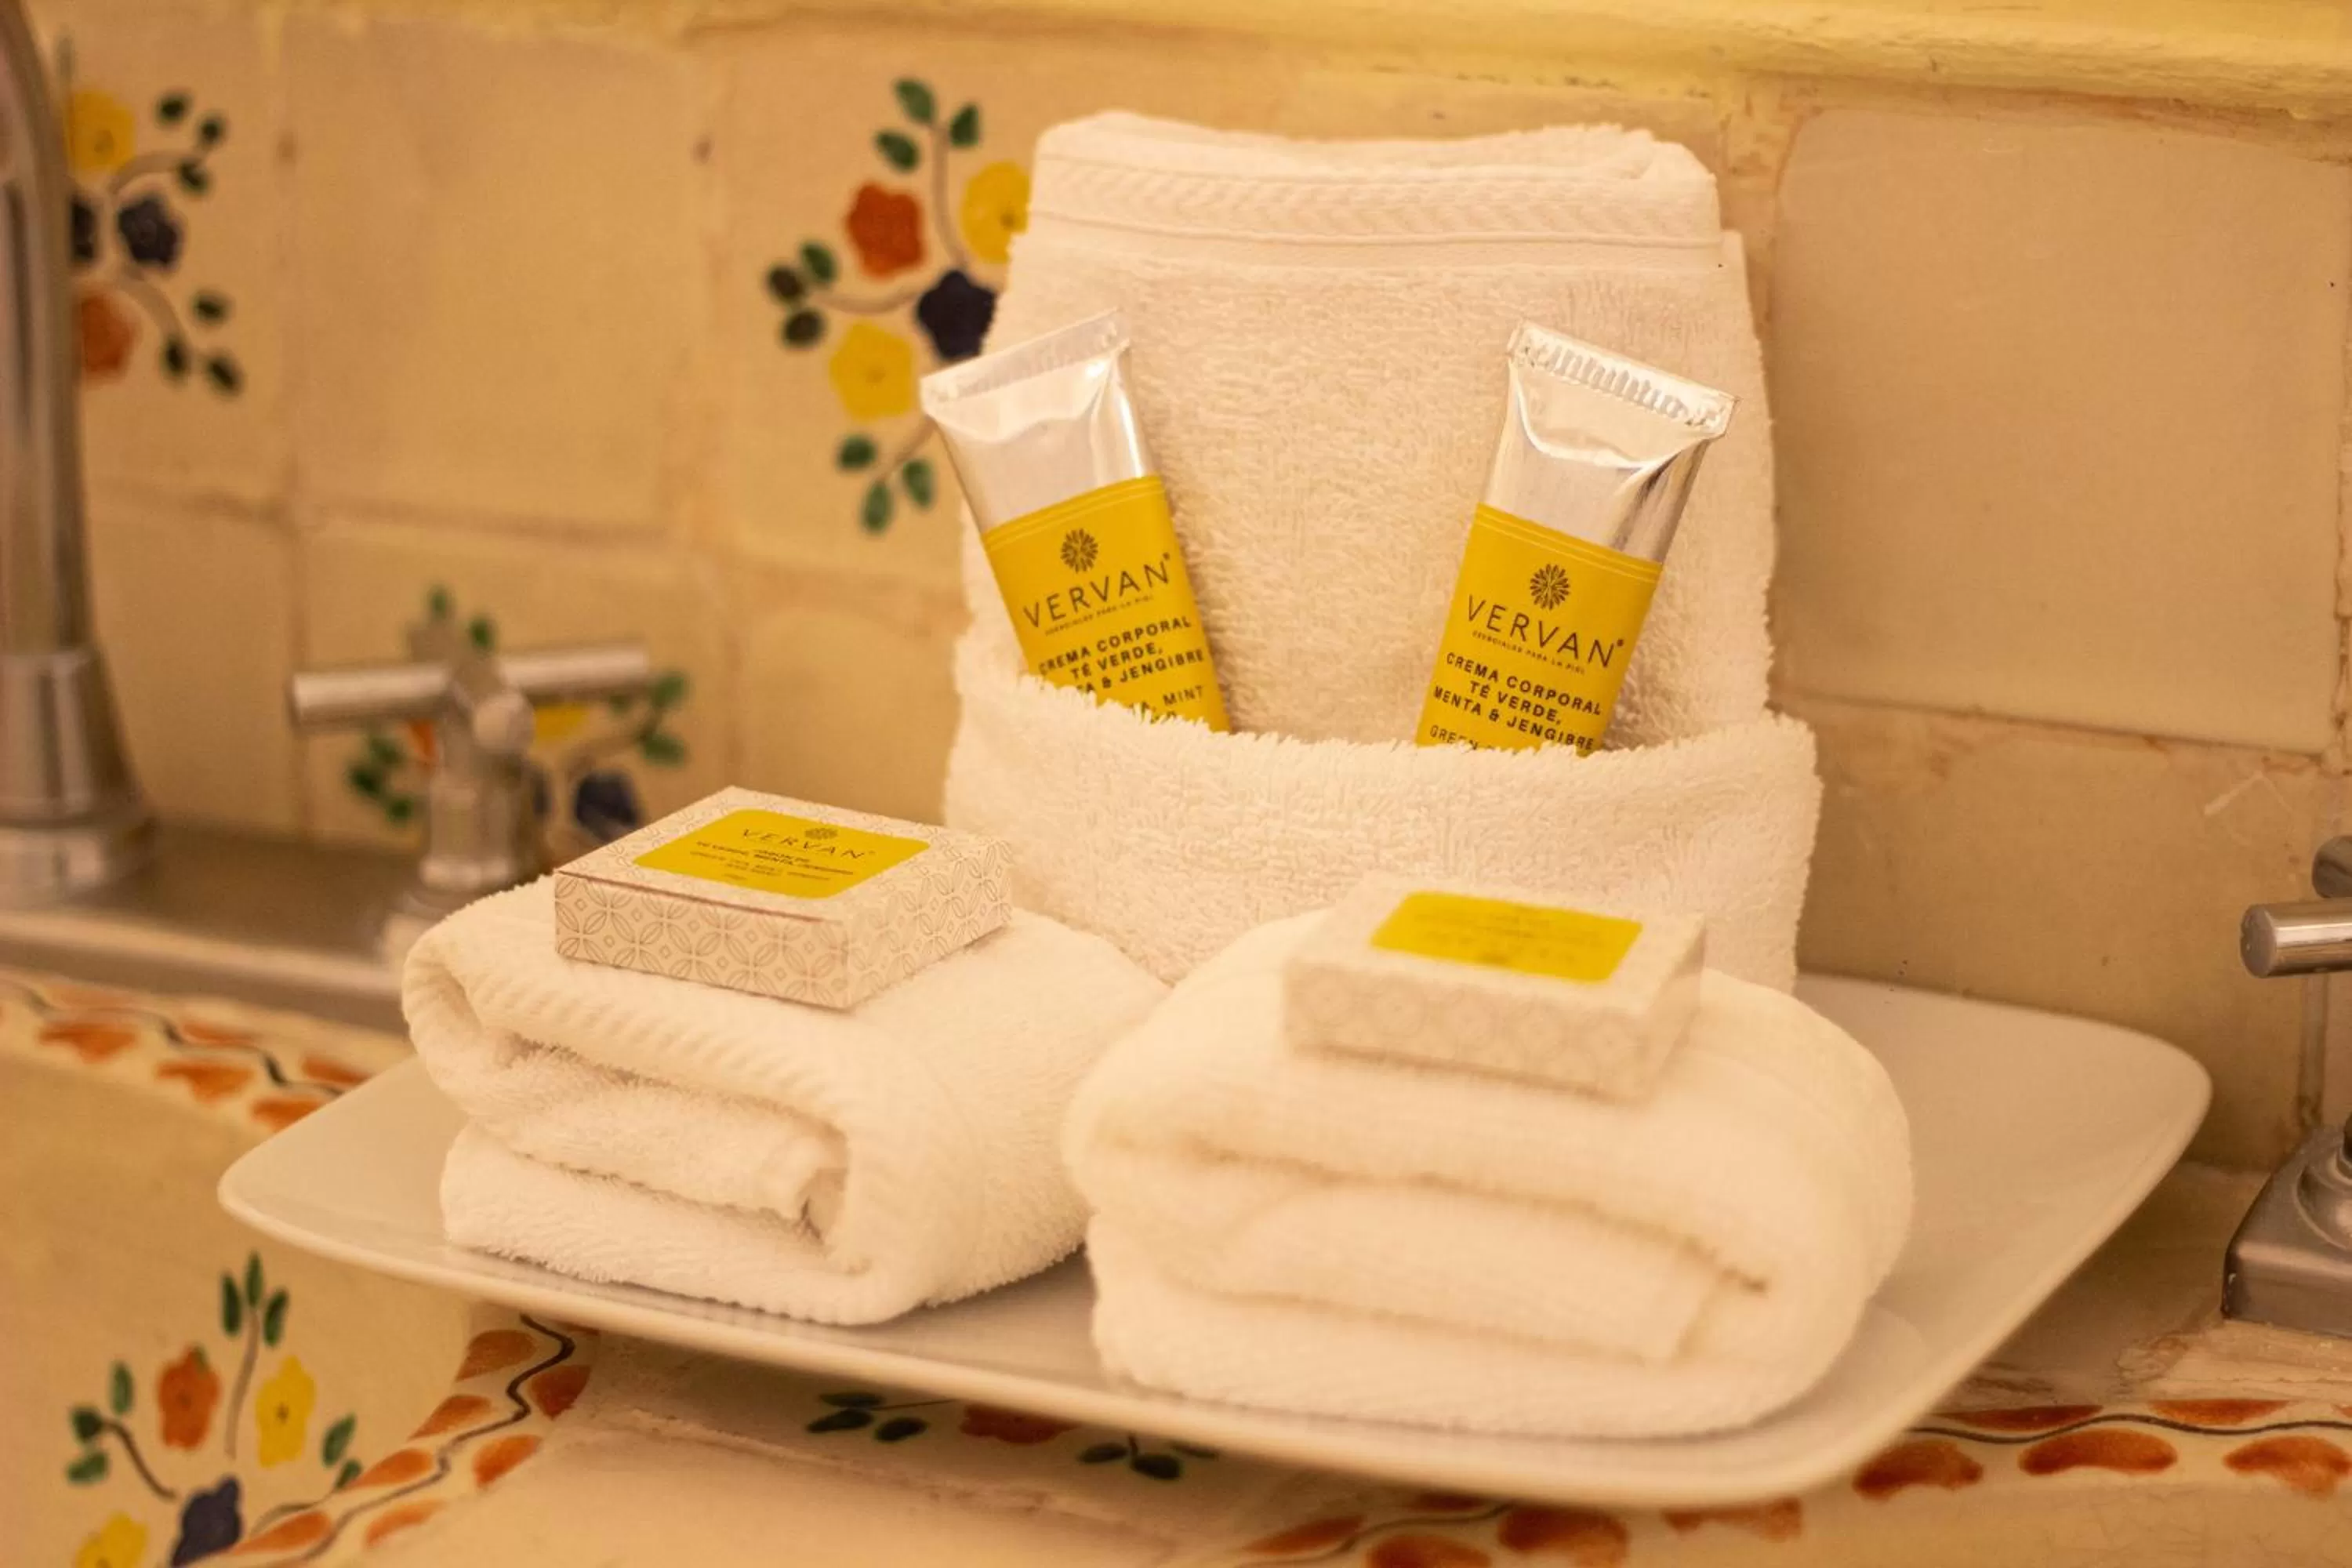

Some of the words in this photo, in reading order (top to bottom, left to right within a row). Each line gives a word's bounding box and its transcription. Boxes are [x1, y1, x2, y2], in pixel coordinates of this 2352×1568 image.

[1038, 646, 1091, 677] CREMA
[1096, 615, 1192, 652] CORPORAL
[1097, 641, 1163, 670] VERDE,
[1120, 648, 1205, 683] JENGIBRE
[1163, 684, 1203, 706] MINT
[1446, 652, 1499, 682] CREMA
[1506, 675, 1602, 716] CORPORAL
[1470, 680, 1490, 699] TÉ
[1497, 691, 1561, 725] VERDE,
[1429, 724, 1479, 750] GREN
[1433, 685, 1481, 716] MENTA
[1488, 708, 1500, 722] &
[1506, 716, 1594, 750] JENGIBRE
